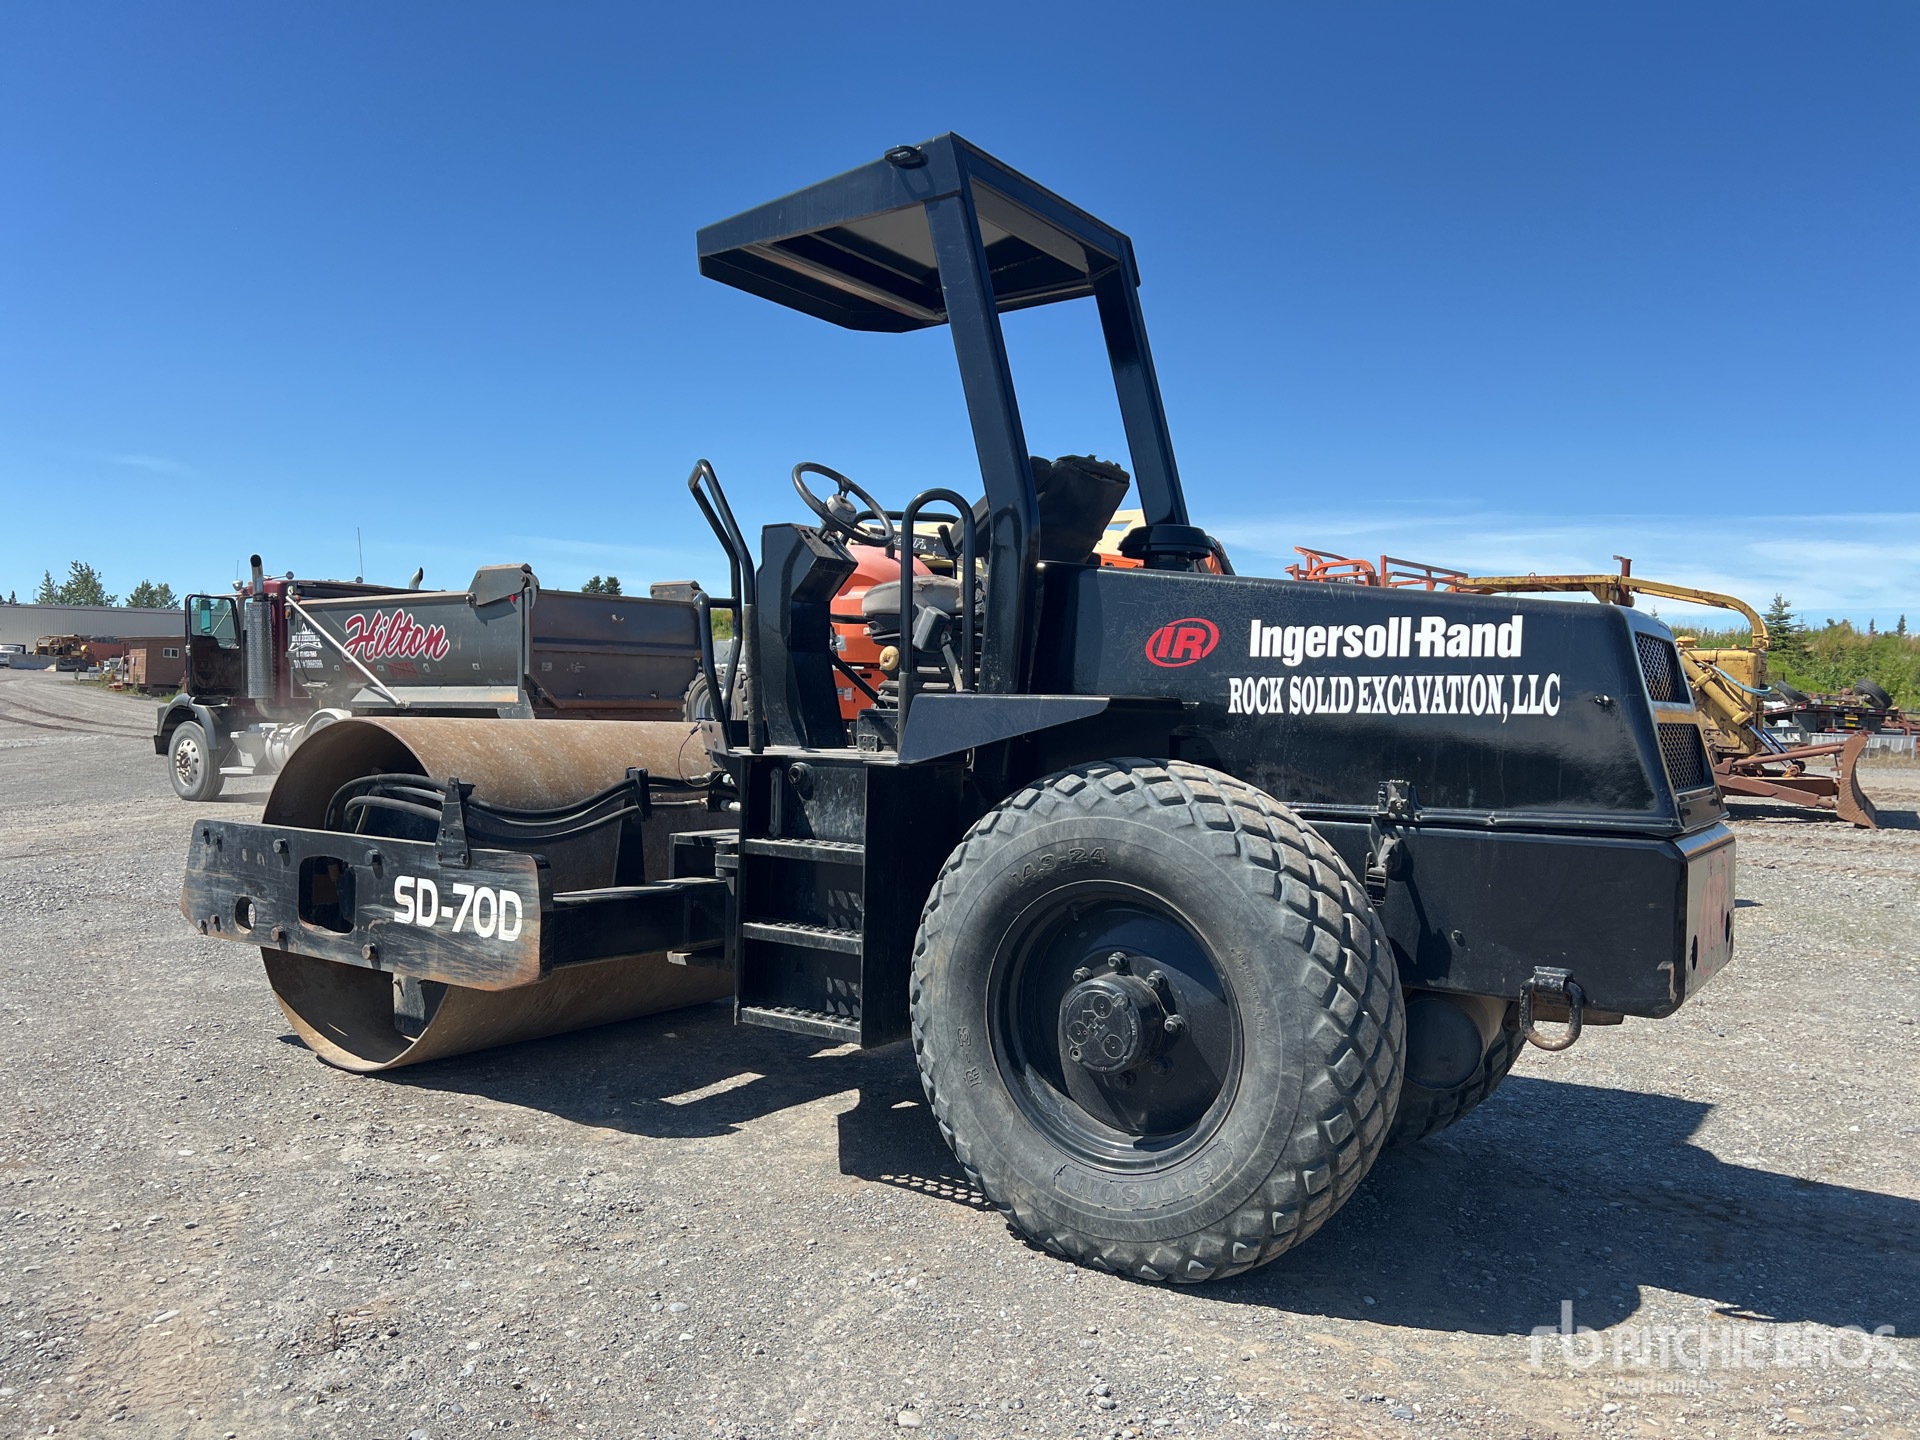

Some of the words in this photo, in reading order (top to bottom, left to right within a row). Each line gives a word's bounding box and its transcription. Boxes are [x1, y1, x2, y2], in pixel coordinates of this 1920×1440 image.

[342, 608, 450, 662] Hilton
[1155, 626, 1204, 660] IR
[1249, 615, 1524, 667] Ingersoll-Rand
[1227, 676, 1285, 716] ROCK
[1288, 675, 1355, 716] SOLID
[1355, 674, 1509, 724] EXCAVATION,
[1510, 672, 1561, 717] LLC
[1008, 846, 1107, 888] 14.9-24
[393, 875, 524, 942] SD-70D
[1074, 1158, 1214, 1206] SAMSON
